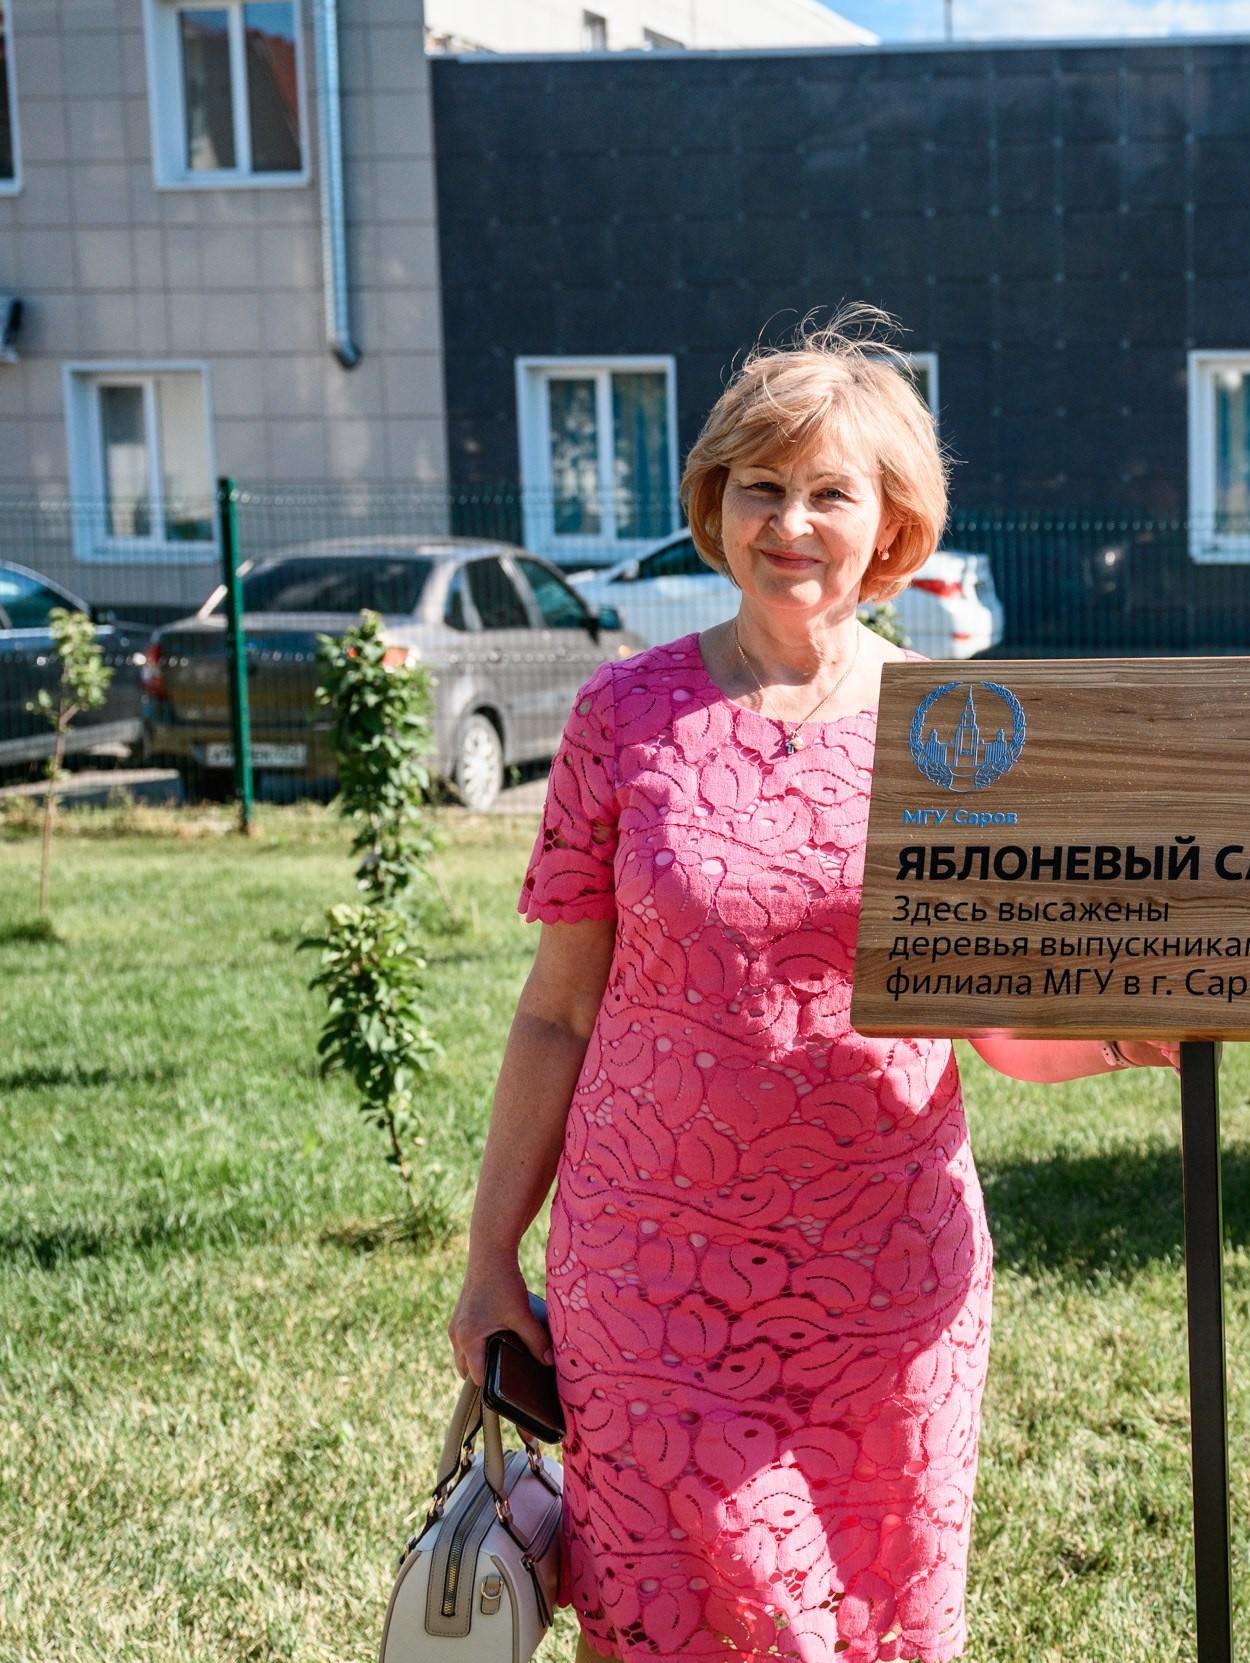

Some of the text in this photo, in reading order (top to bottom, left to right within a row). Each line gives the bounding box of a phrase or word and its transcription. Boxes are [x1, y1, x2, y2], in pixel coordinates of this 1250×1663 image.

[903, 809, 1018, 829] МГУ Саров
[895, 835, 1200, 881] ЯБЛОНЕВЫЙ
[892, 895, 1170, 927] Здесь высажены
[888, 935, 1029, 964] деревья
[886, 966, 1032, 1002] филиала
[1043, 968, 1114, 996] МГУ
[1123, 975, 1141, 996] в
[1152, 975, 1172, 996] г.
